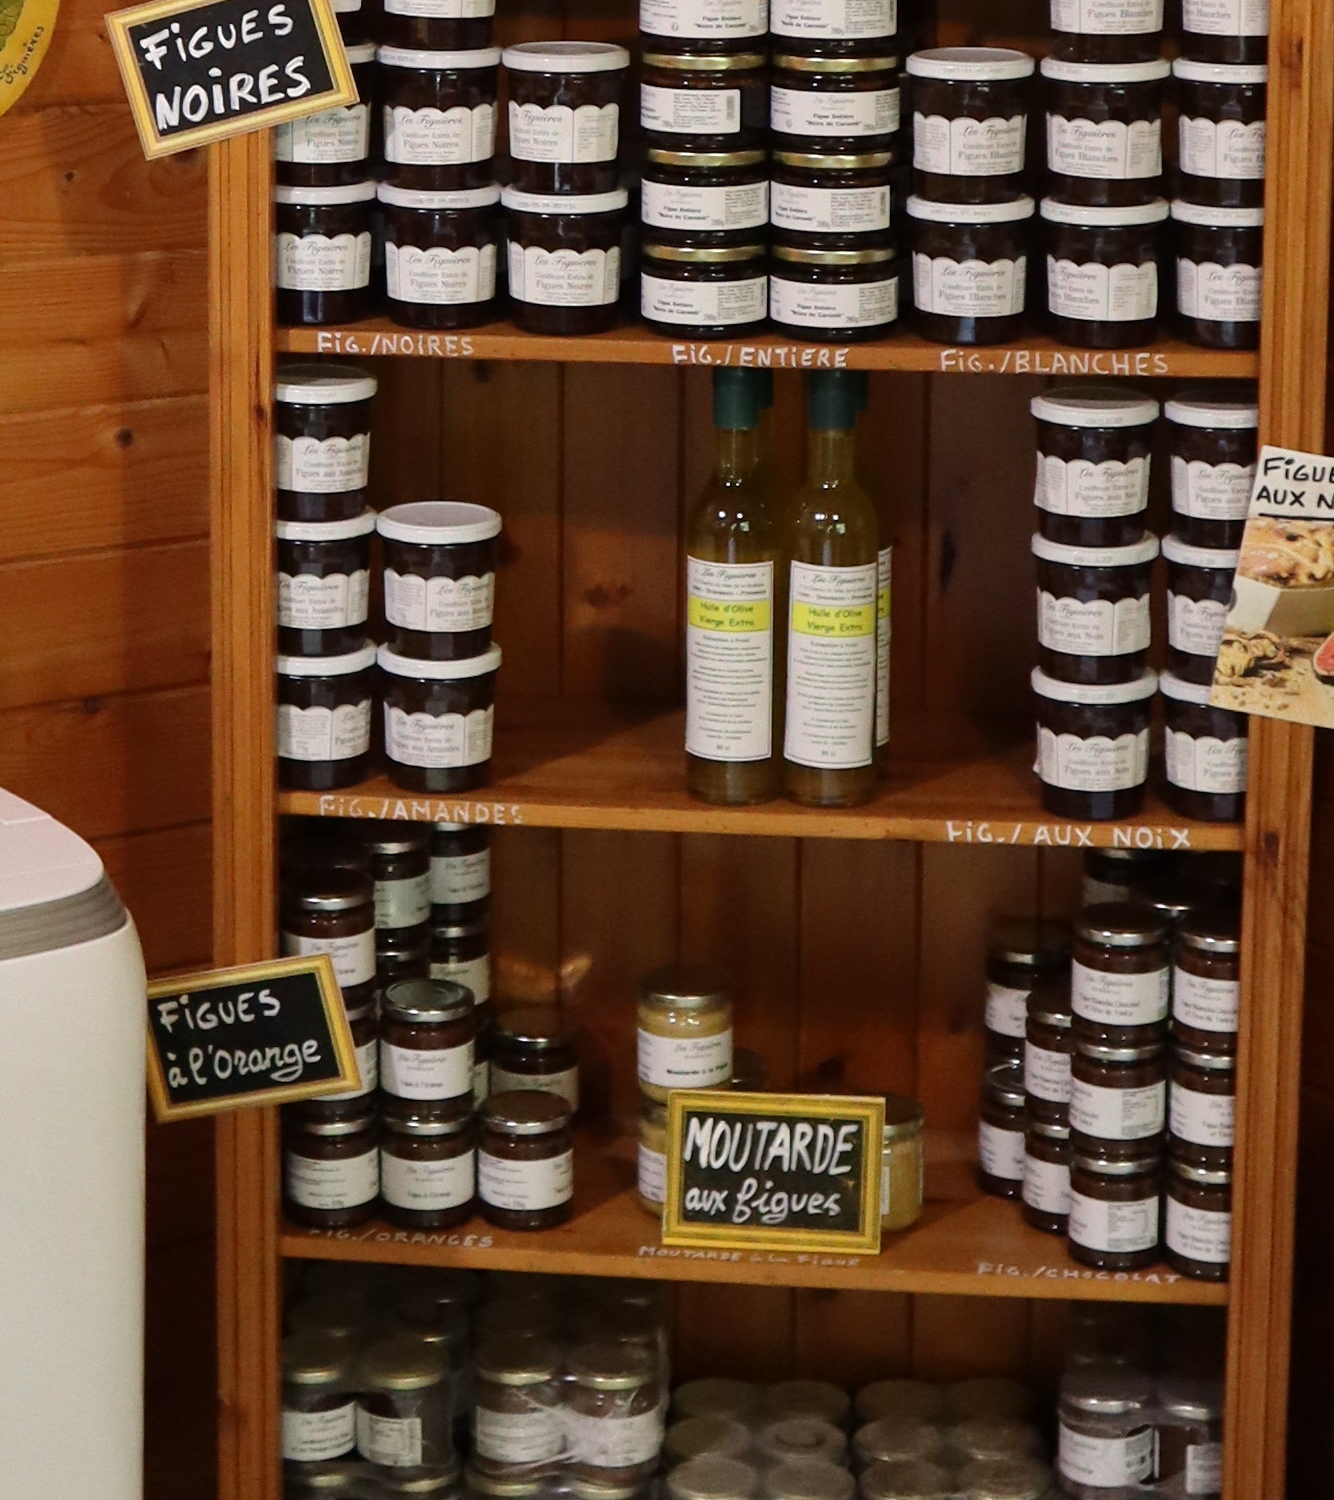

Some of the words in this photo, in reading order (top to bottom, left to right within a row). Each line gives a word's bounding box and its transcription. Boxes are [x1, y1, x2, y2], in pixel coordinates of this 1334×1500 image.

[1256, 486, 1308, 507] AUX
[1034, 827, 1093, 847] AUX
[168, 1052, 188, 1088] à
[684, 1116, 858, 1175] MOUTARDE
[685, 1190, 729, 1215] aux
[735, 1179, 841, 1224] figues
[639, 1245, 741, 1264] MOUTARDE
